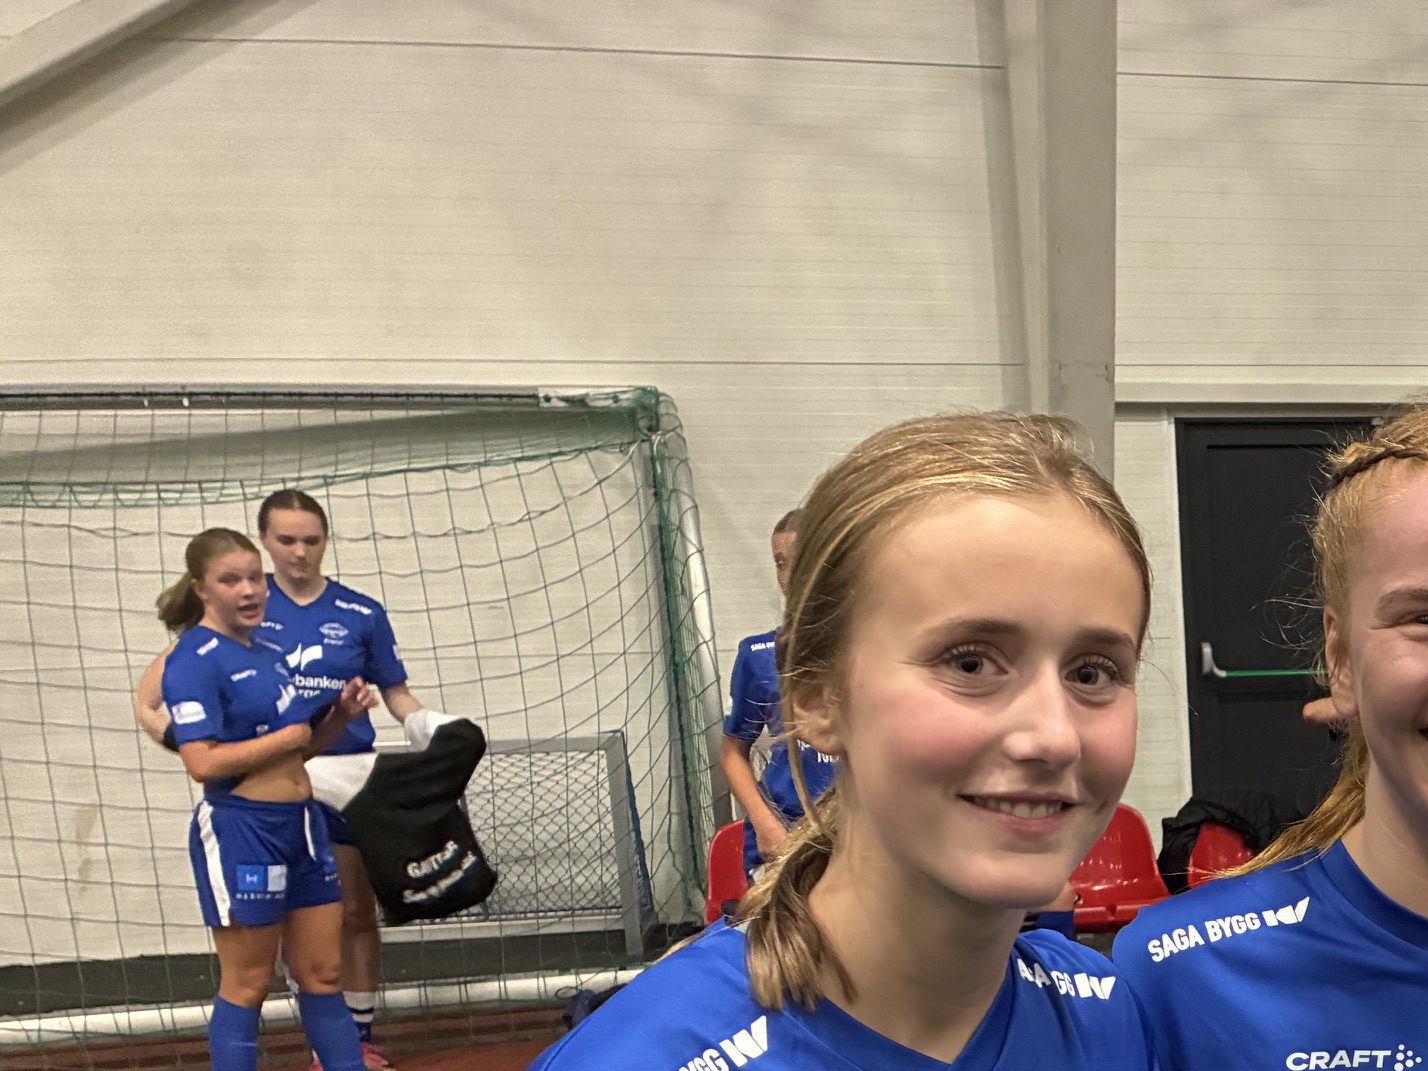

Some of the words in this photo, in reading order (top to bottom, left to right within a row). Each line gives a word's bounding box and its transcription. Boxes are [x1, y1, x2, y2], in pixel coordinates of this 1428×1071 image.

[295, 673, 347, 690] banken
[1148, 924, 1205, 962] SAGA
[1205, 912, 1261, 943] BYGG
[1286, 1049, 1392, 1071] CRAFT
